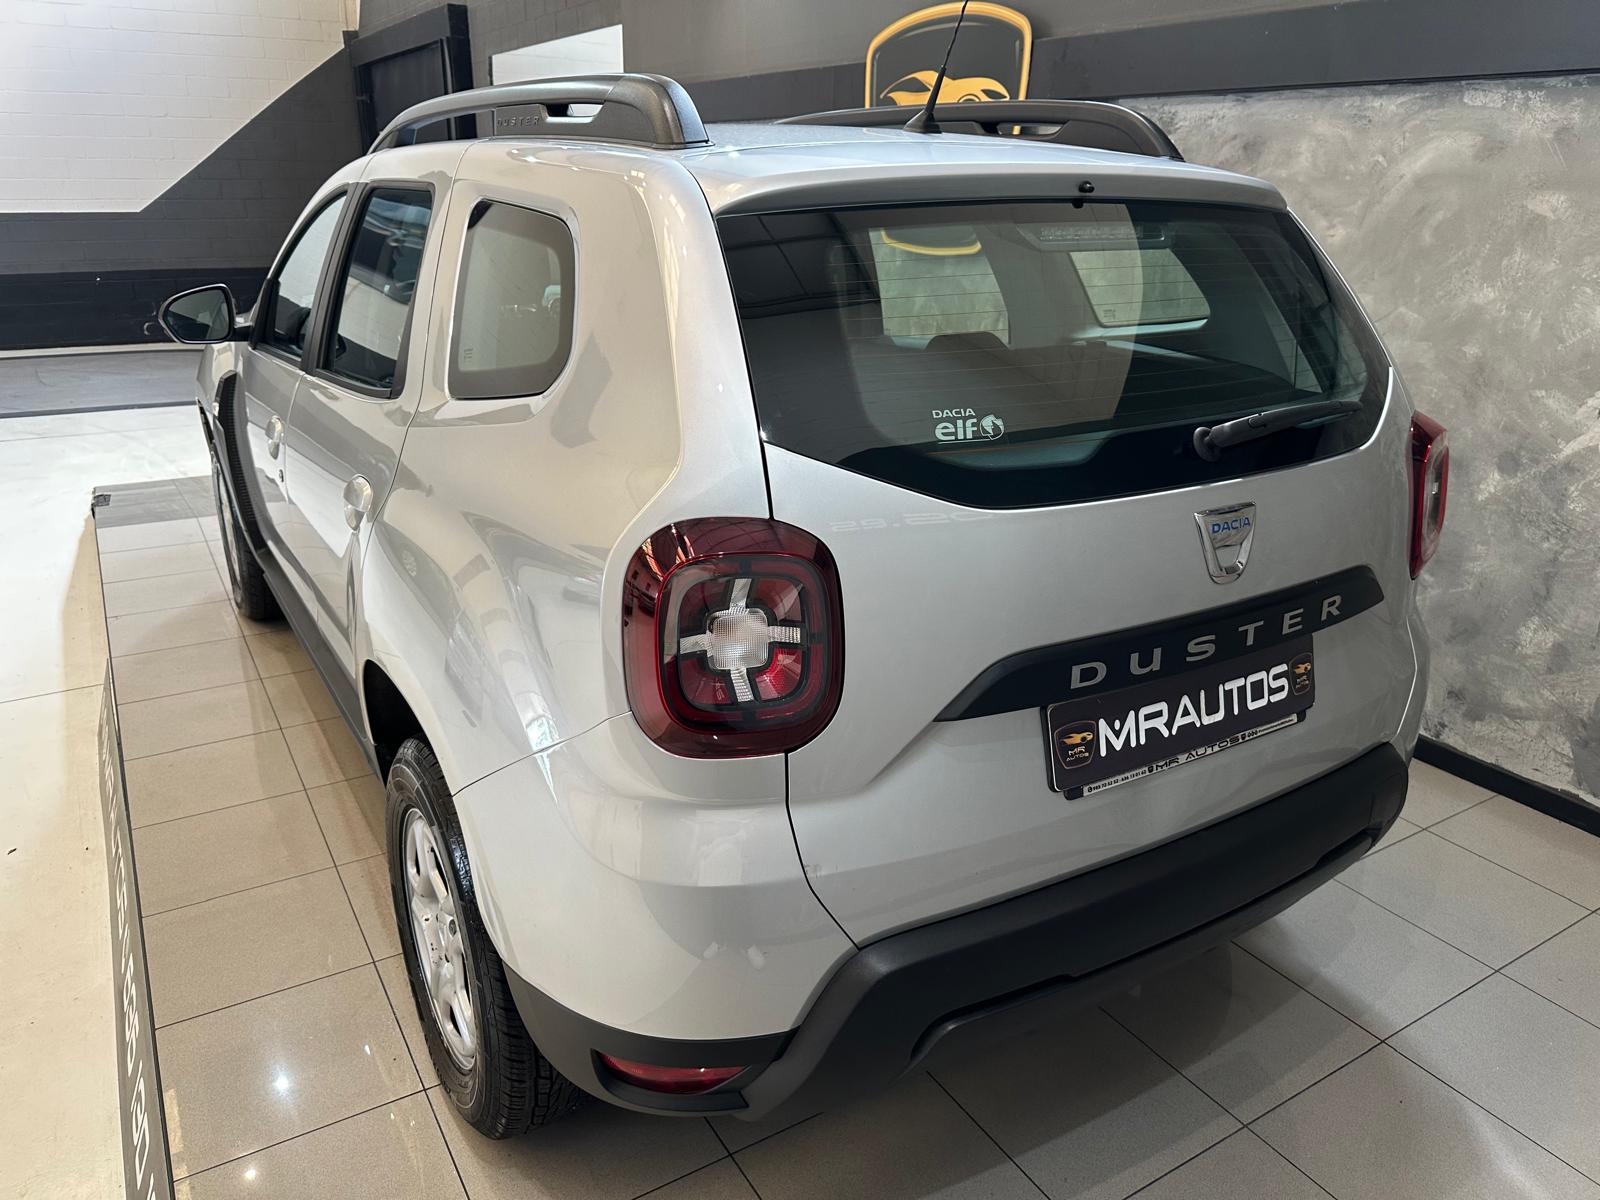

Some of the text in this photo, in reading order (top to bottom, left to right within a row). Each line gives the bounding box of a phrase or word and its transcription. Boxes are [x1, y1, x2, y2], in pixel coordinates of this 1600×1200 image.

[496, 116, 540, 127] DUSTER
[932, 408, 976, 419] DACIA
[935, 418, 978, 441] elf
[1211, 517, 1250, 534] DACIA
[1070, 594, 1343, 690] DUSTER
[1068, 746, 1086, 756] MR
[1156, 757, 1180, 771] MR
[1186, 735, 1240, 761] AUTOS
